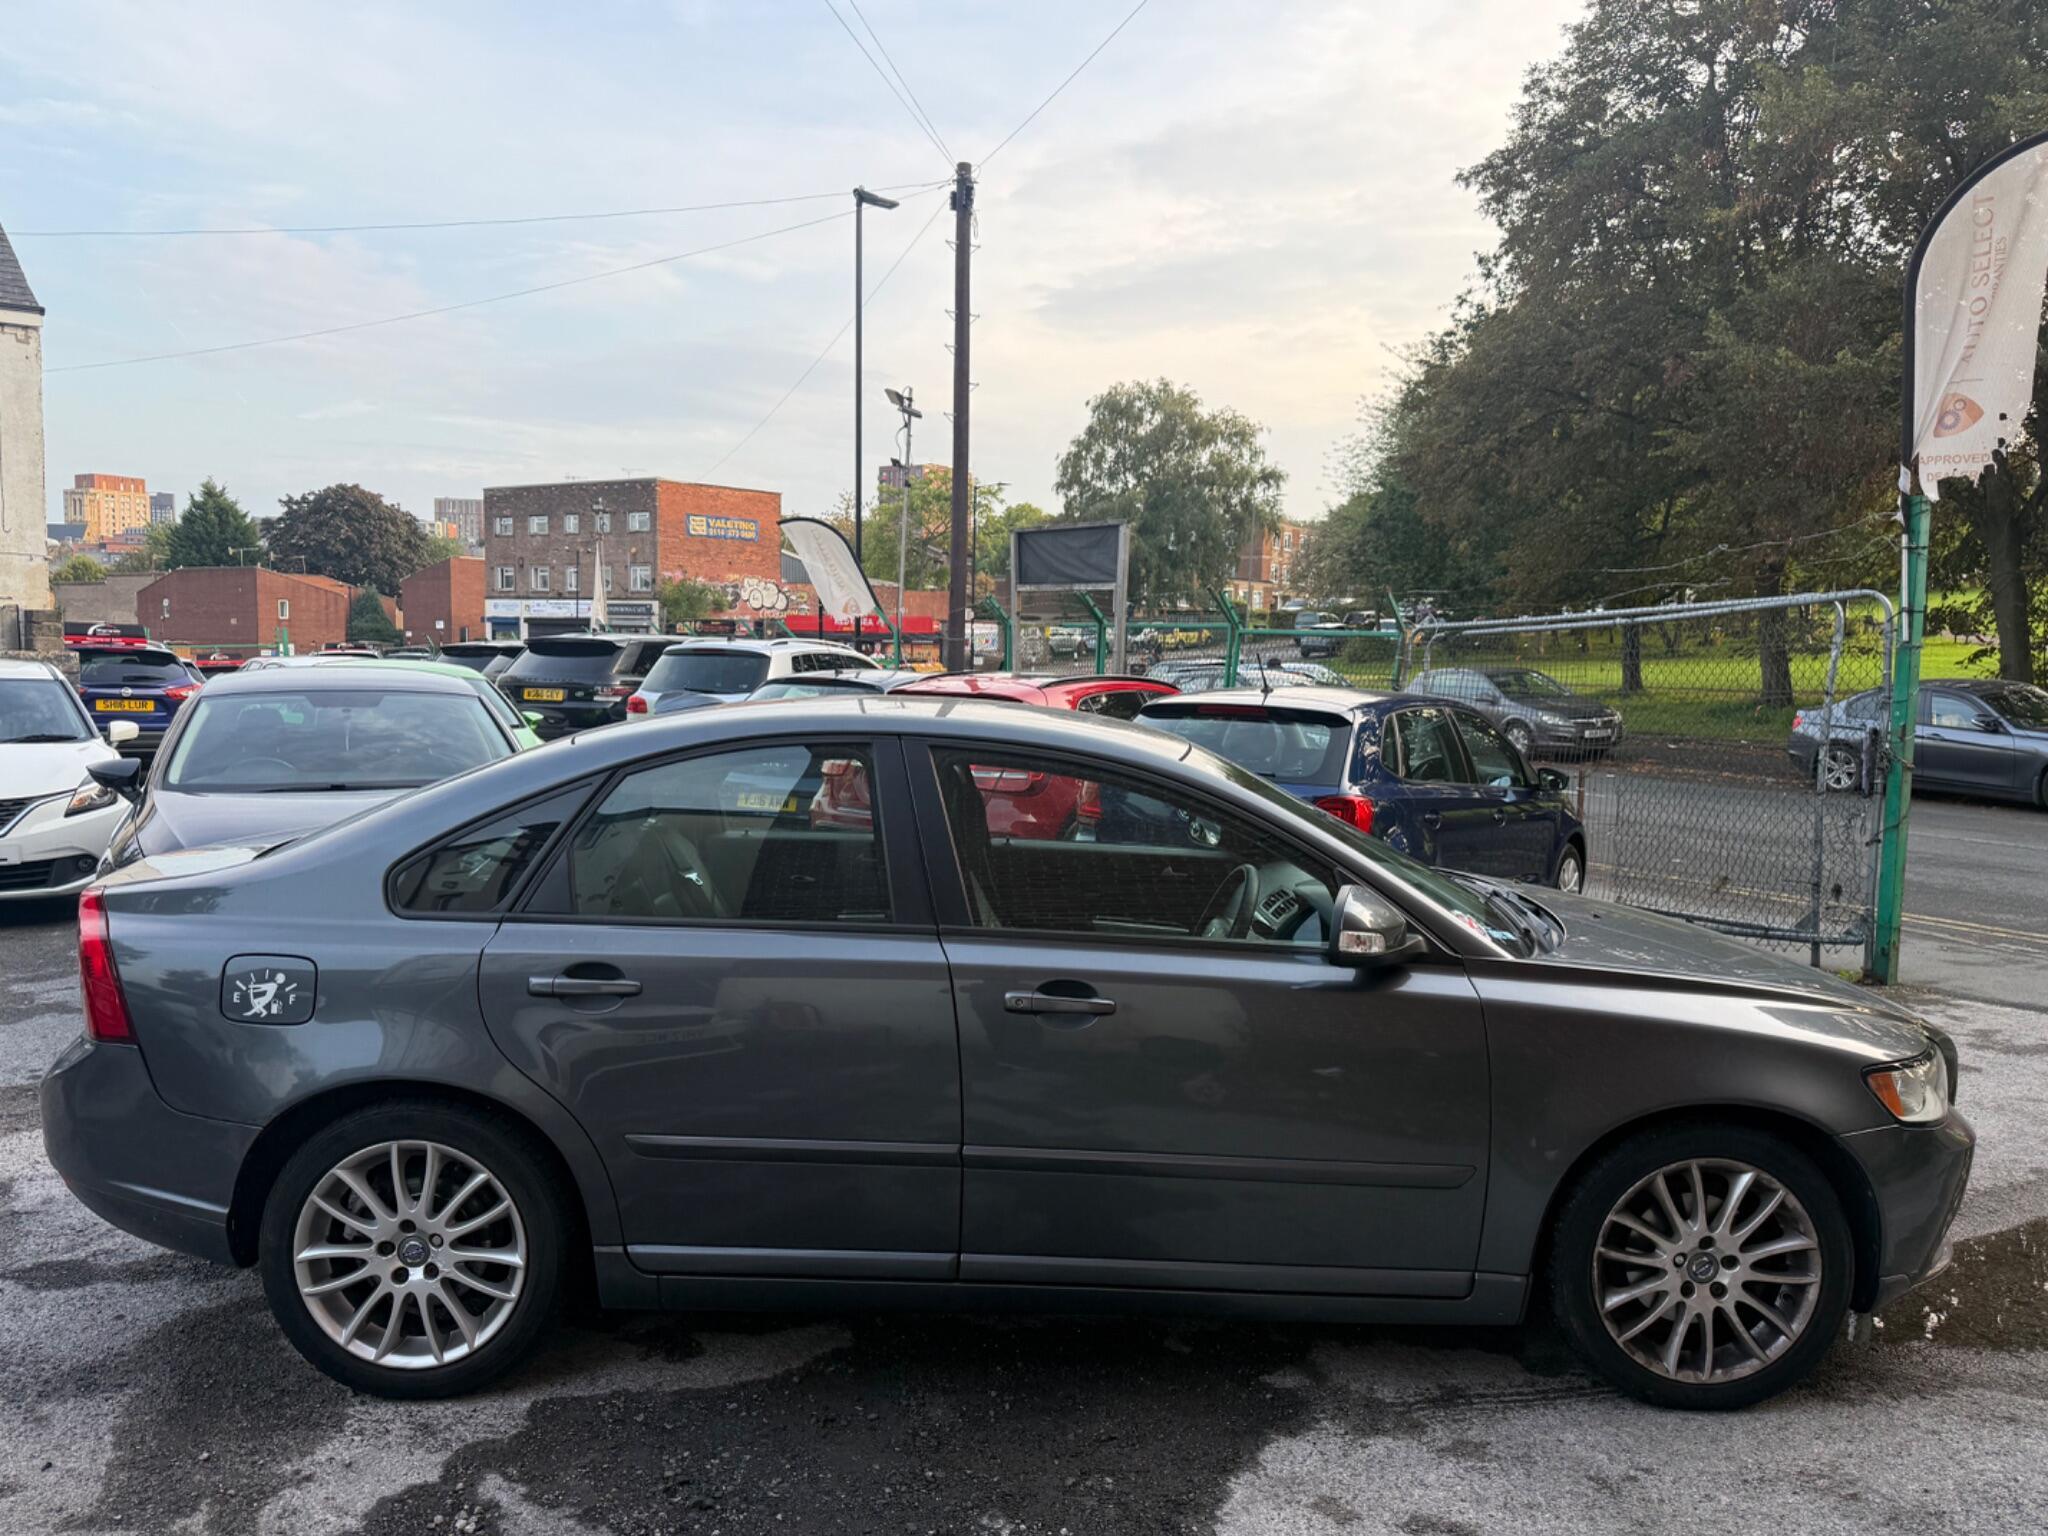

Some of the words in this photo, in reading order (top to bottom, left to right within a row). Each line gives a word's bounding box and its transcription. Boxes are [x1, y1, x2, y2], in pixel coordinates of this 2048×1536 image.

[1971, 194, 1995, 289] SELECT
[1919, 453, 1991, 465] APPROVED
[128, 701, 149, 709] LUR
[233, 992, 240, 1003] E
[289, 995, 296, 1005] F
